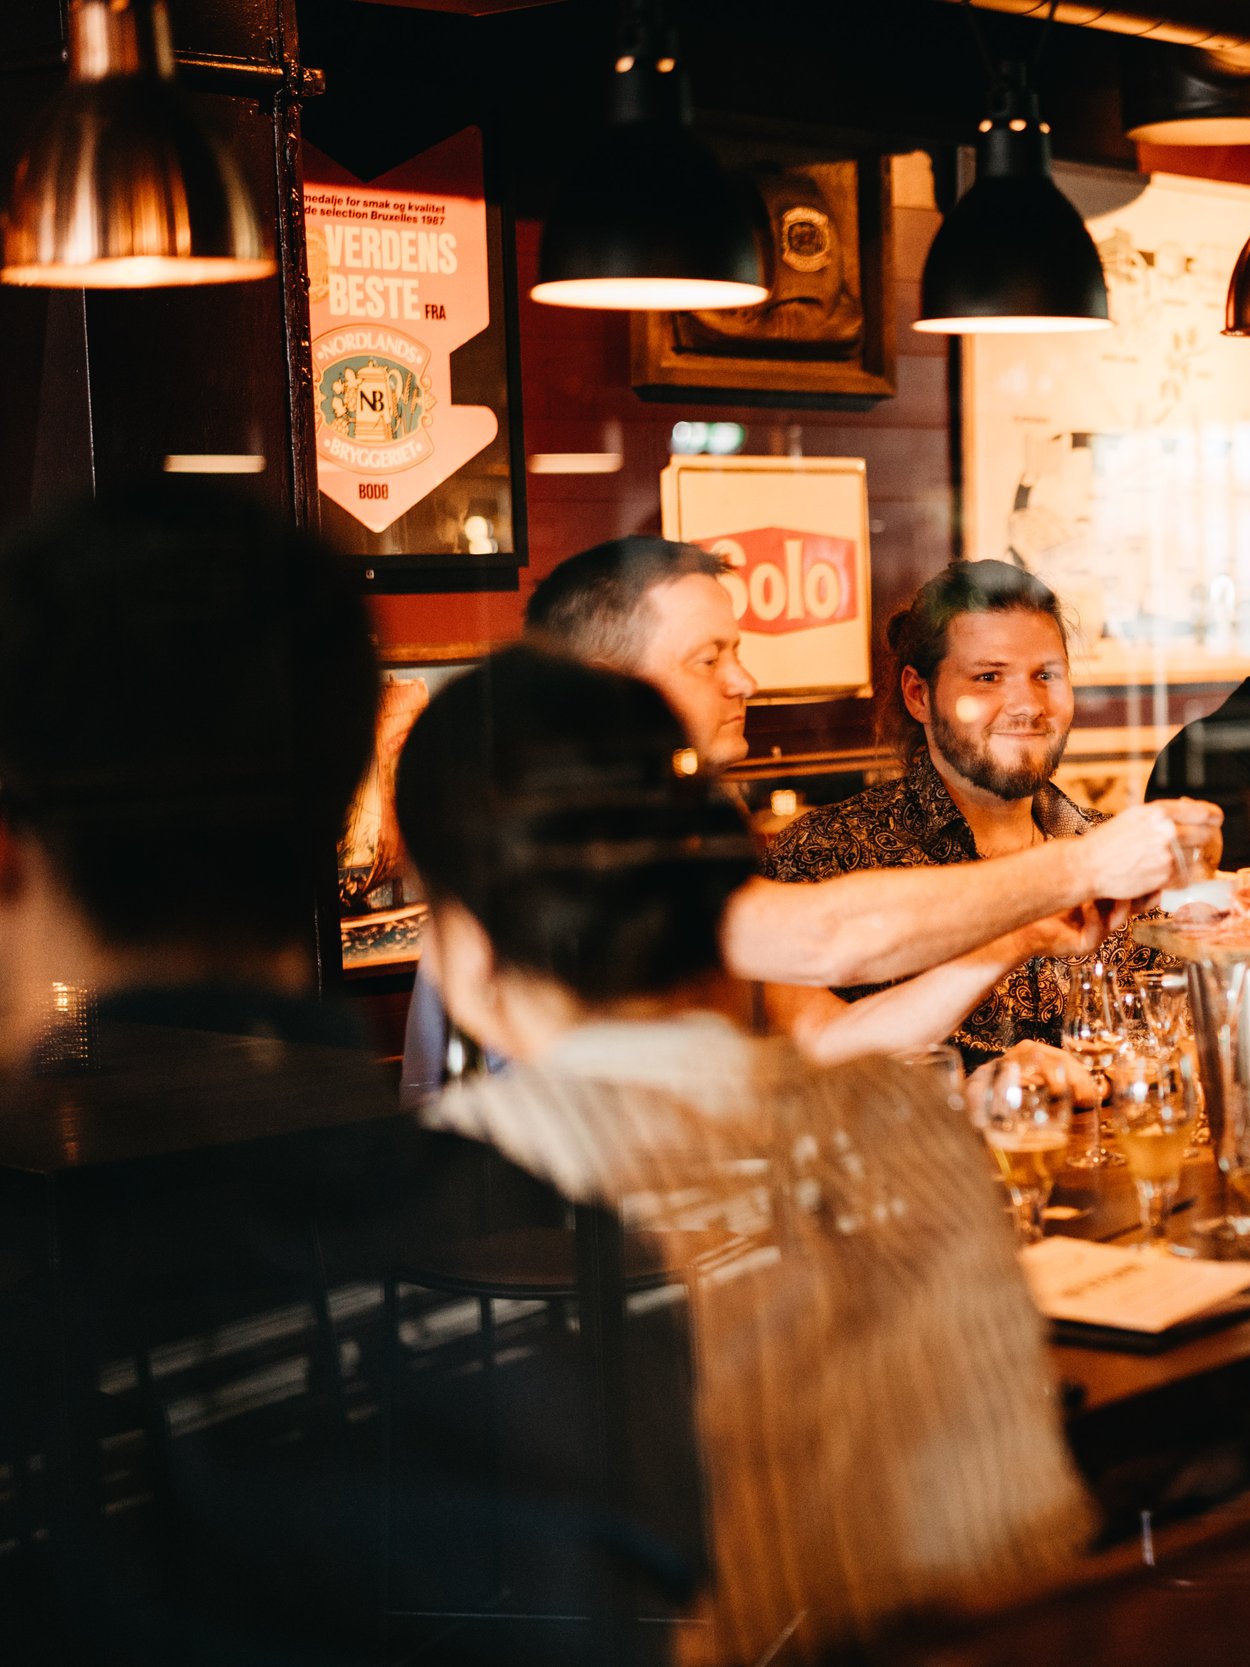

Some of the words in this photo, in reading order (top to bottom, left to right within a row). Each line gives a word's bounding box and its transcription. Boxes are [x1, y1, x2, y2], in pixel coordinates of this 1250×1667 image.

[320, 207, 368, 219] selection
[370, 211, 418, 224] Bruxelles
[421, 216, 446, 226] 1987
[346, 196, 361, 206] for
[363, 200, 390, 209] smak
[393, 203, 405, 213] og
[408, 202, 446, 214] kvalitet
[323, 224, 458, 275] VERDENS
[328, 274, 421, 320] BESTE
[424, 304, 447, 320] FRA
[322, 332, 418, 362] NORDLANDS
[328, 438, 418, 468] BRYGGERIET
